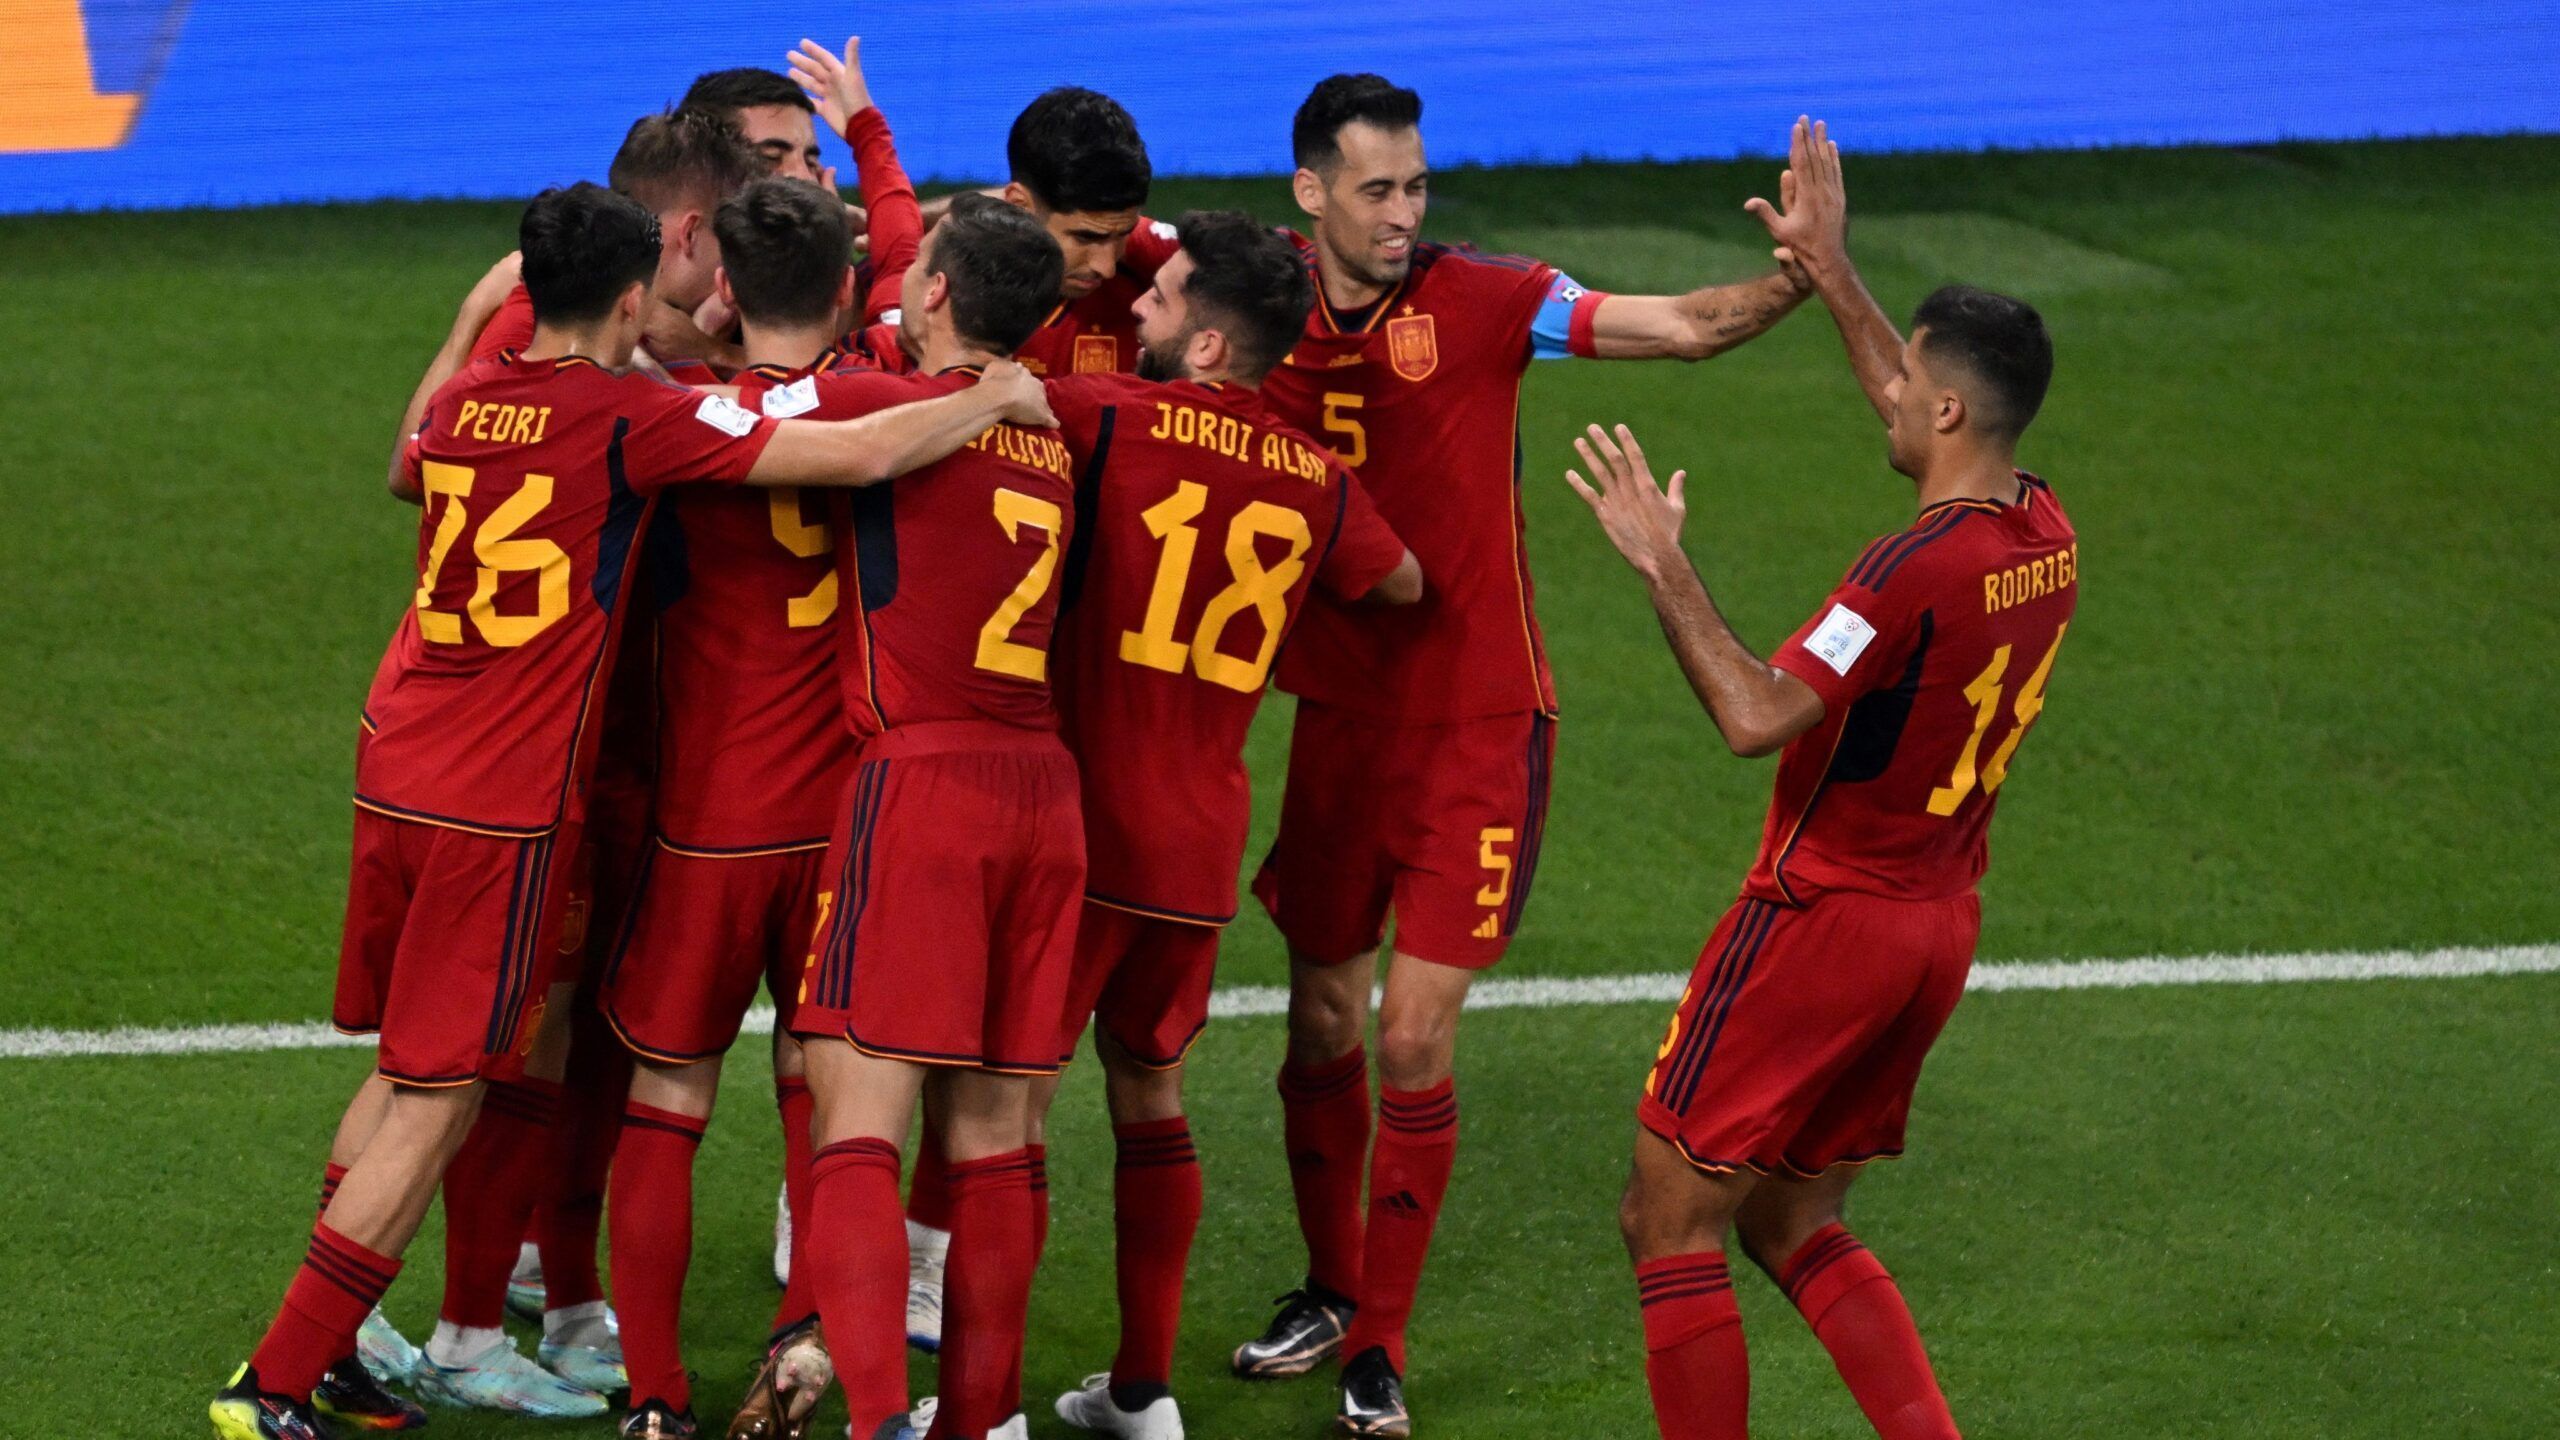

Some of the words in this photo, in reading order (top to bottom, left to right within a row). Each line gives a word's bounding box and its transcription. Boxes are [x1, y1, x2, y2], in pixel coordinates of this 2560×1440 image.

[453, 400, 552, 443] PEDRI
[1151, 402, 1253, 463] JORDI
[1263, 433, 1326, 487] ALBA
[1323, 391, 1367, 467] 5
[416, 460, 571, 648] 26
[974, 488, 1062, 683] 2
[1119, 480, 1312, 693] 18
[1476, 827, 1514, 907] 5
